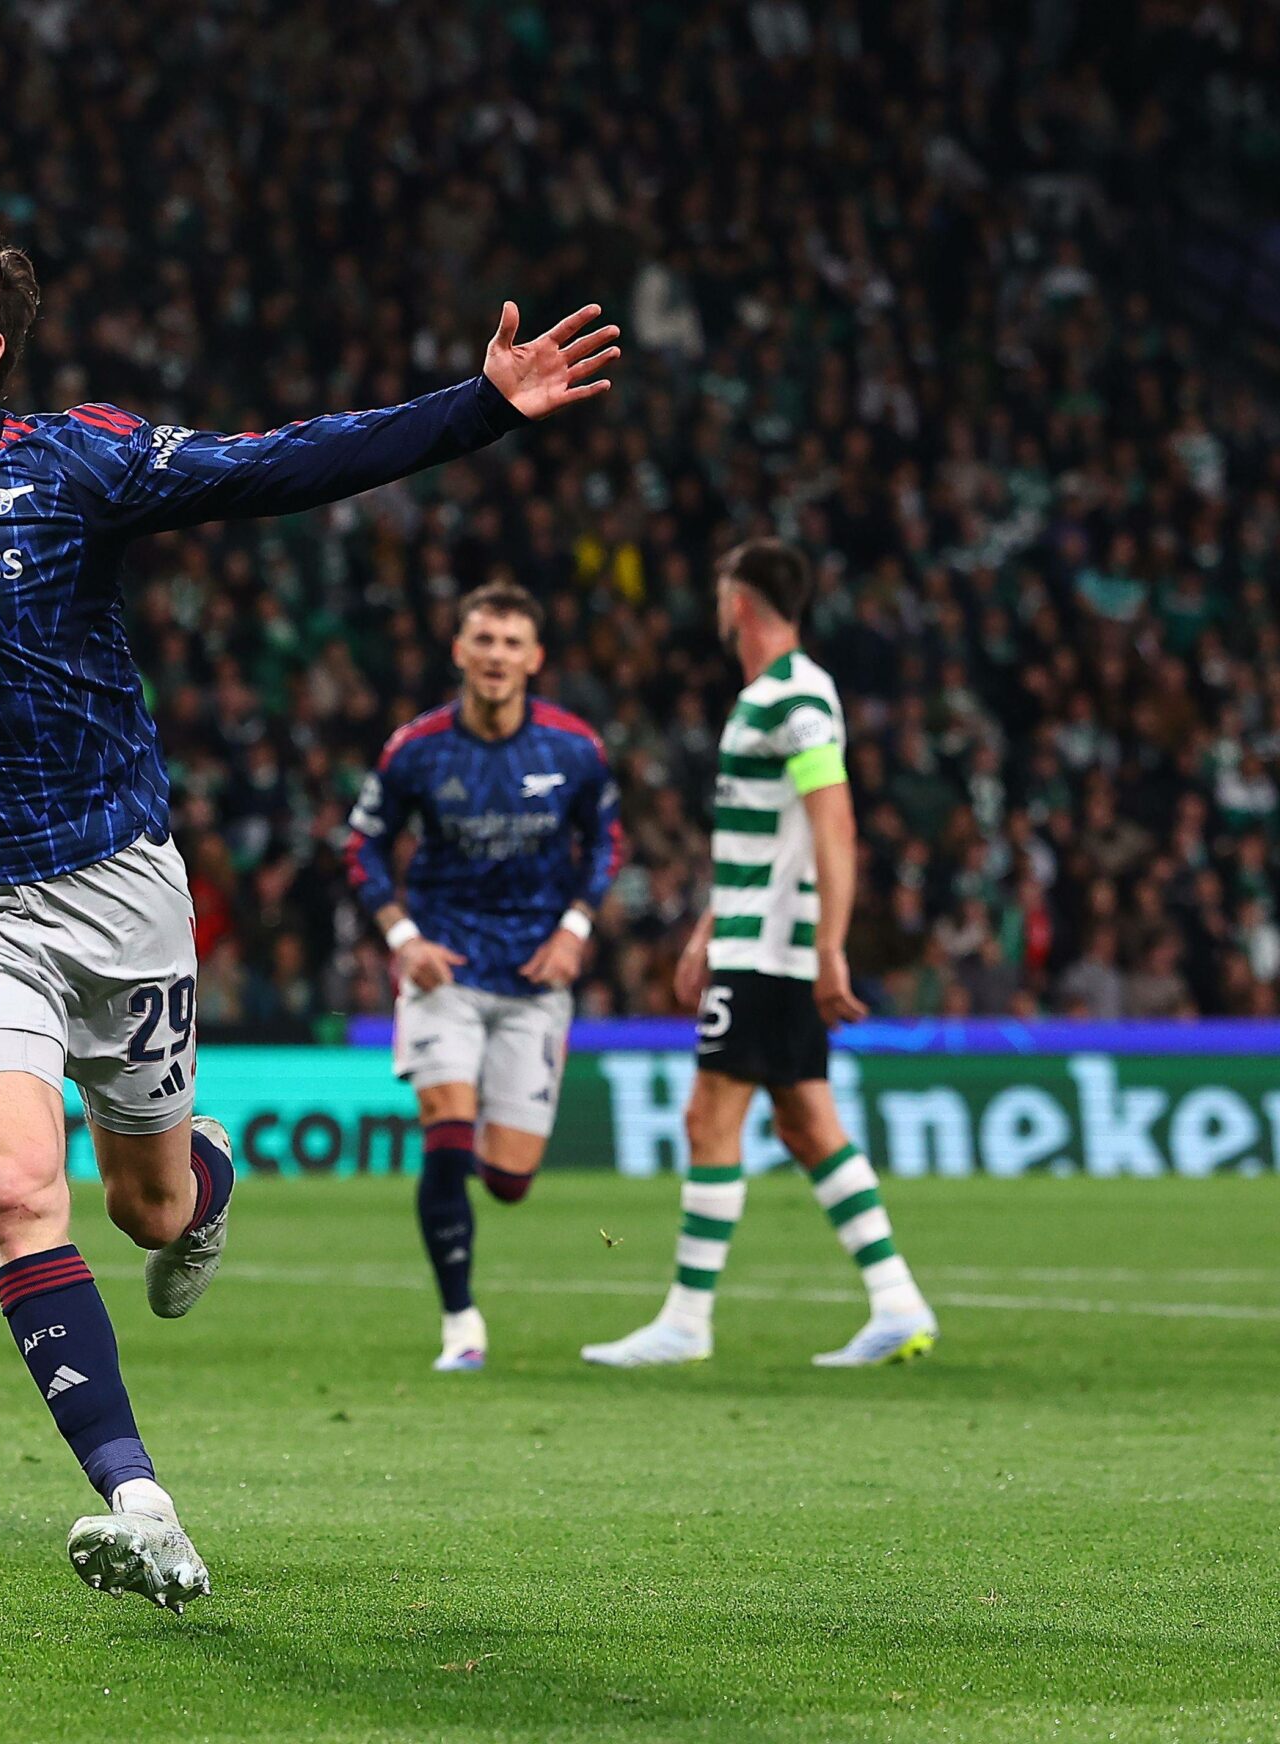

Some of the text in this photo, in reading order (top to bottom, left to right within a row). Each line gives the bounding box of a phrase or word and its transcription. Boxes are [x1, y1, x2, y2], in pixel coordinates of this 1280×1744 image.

[127, 974, 195, 1064] 29
[598, 1053, 1280, 1179] Heineke
[23, 1325, 67, 1356] AFC
